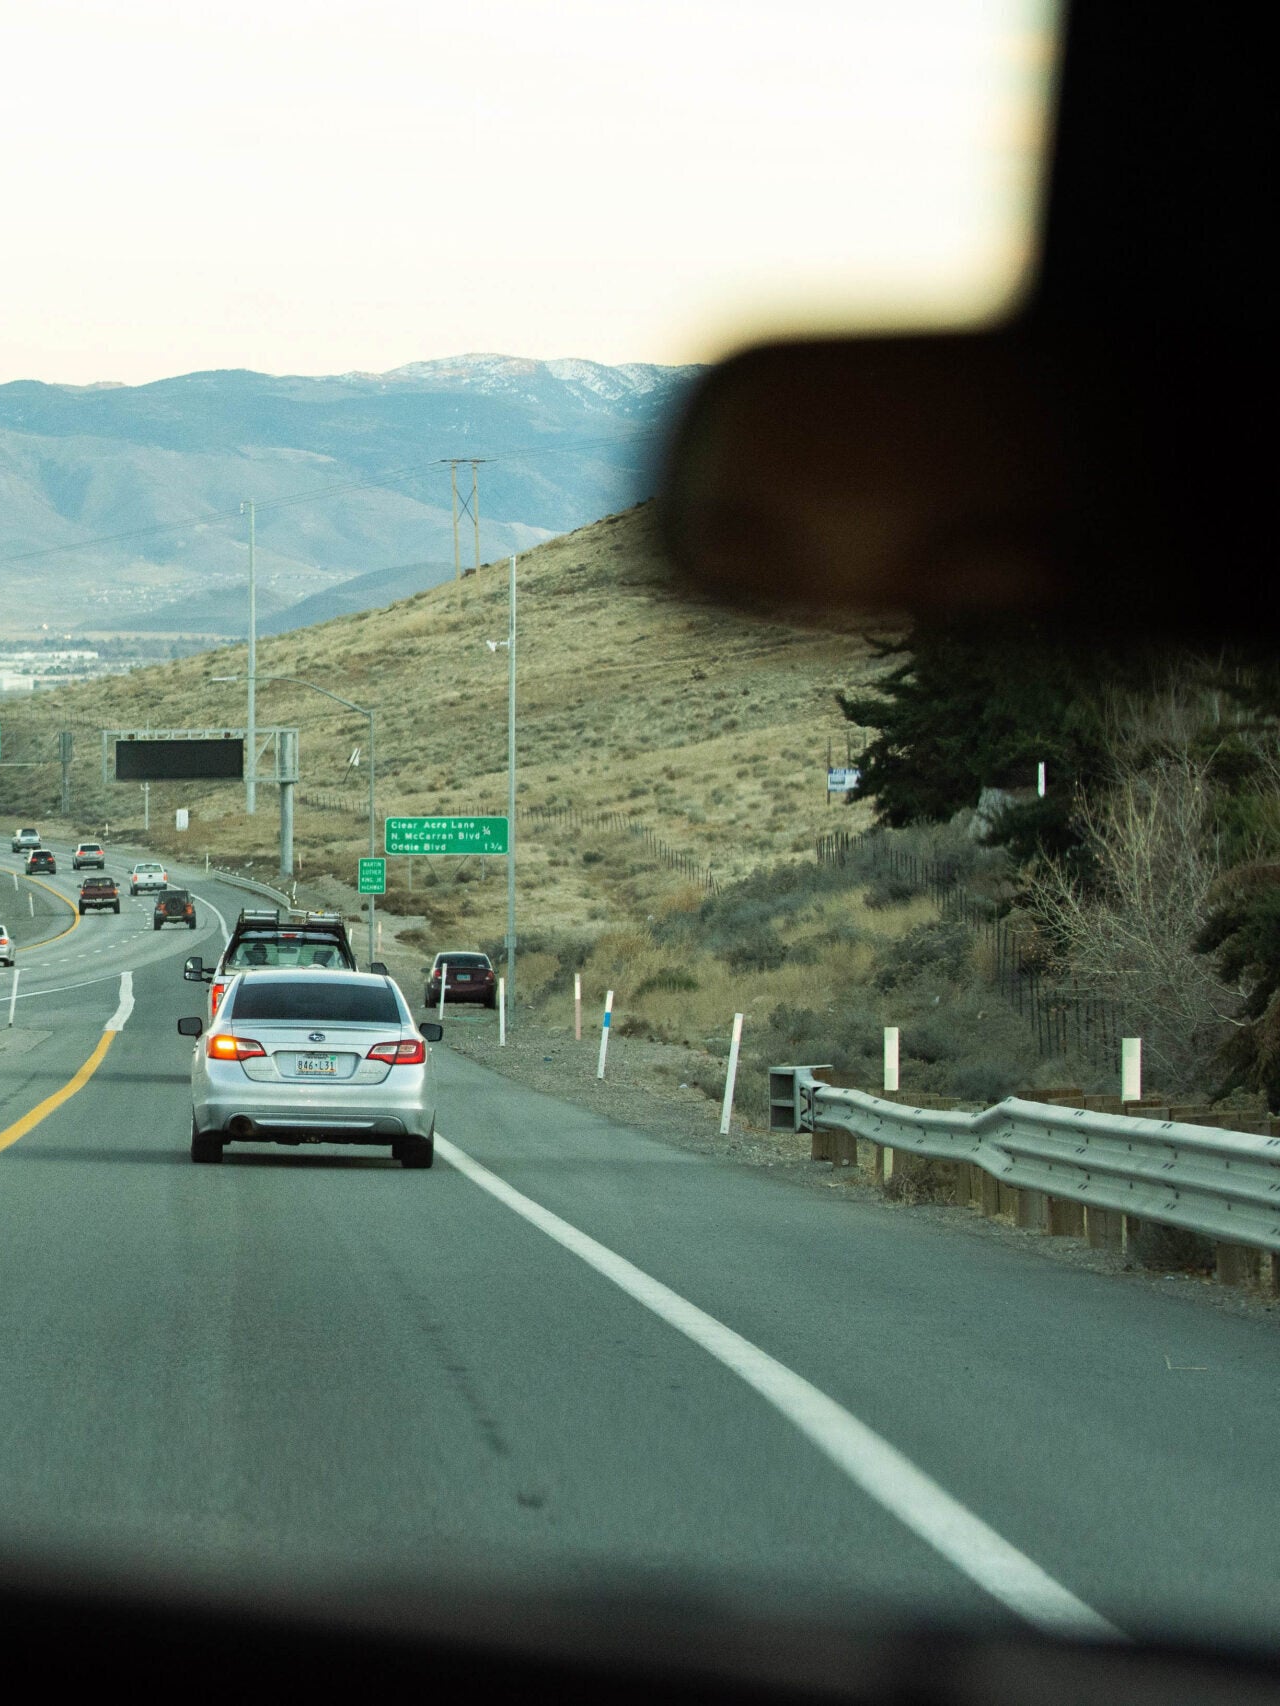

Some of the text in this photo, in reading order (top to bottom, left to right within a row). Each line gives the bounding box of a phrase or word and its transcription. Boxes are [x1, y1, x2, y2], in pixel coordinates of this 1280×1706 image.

[391, 821, 475, 829] Clear Acre Lane
[404, 832, 454, 840] McCarran
[458, 832, 480, 840] Blvd
[391, 842, 447, 851] Oddie Blvd
